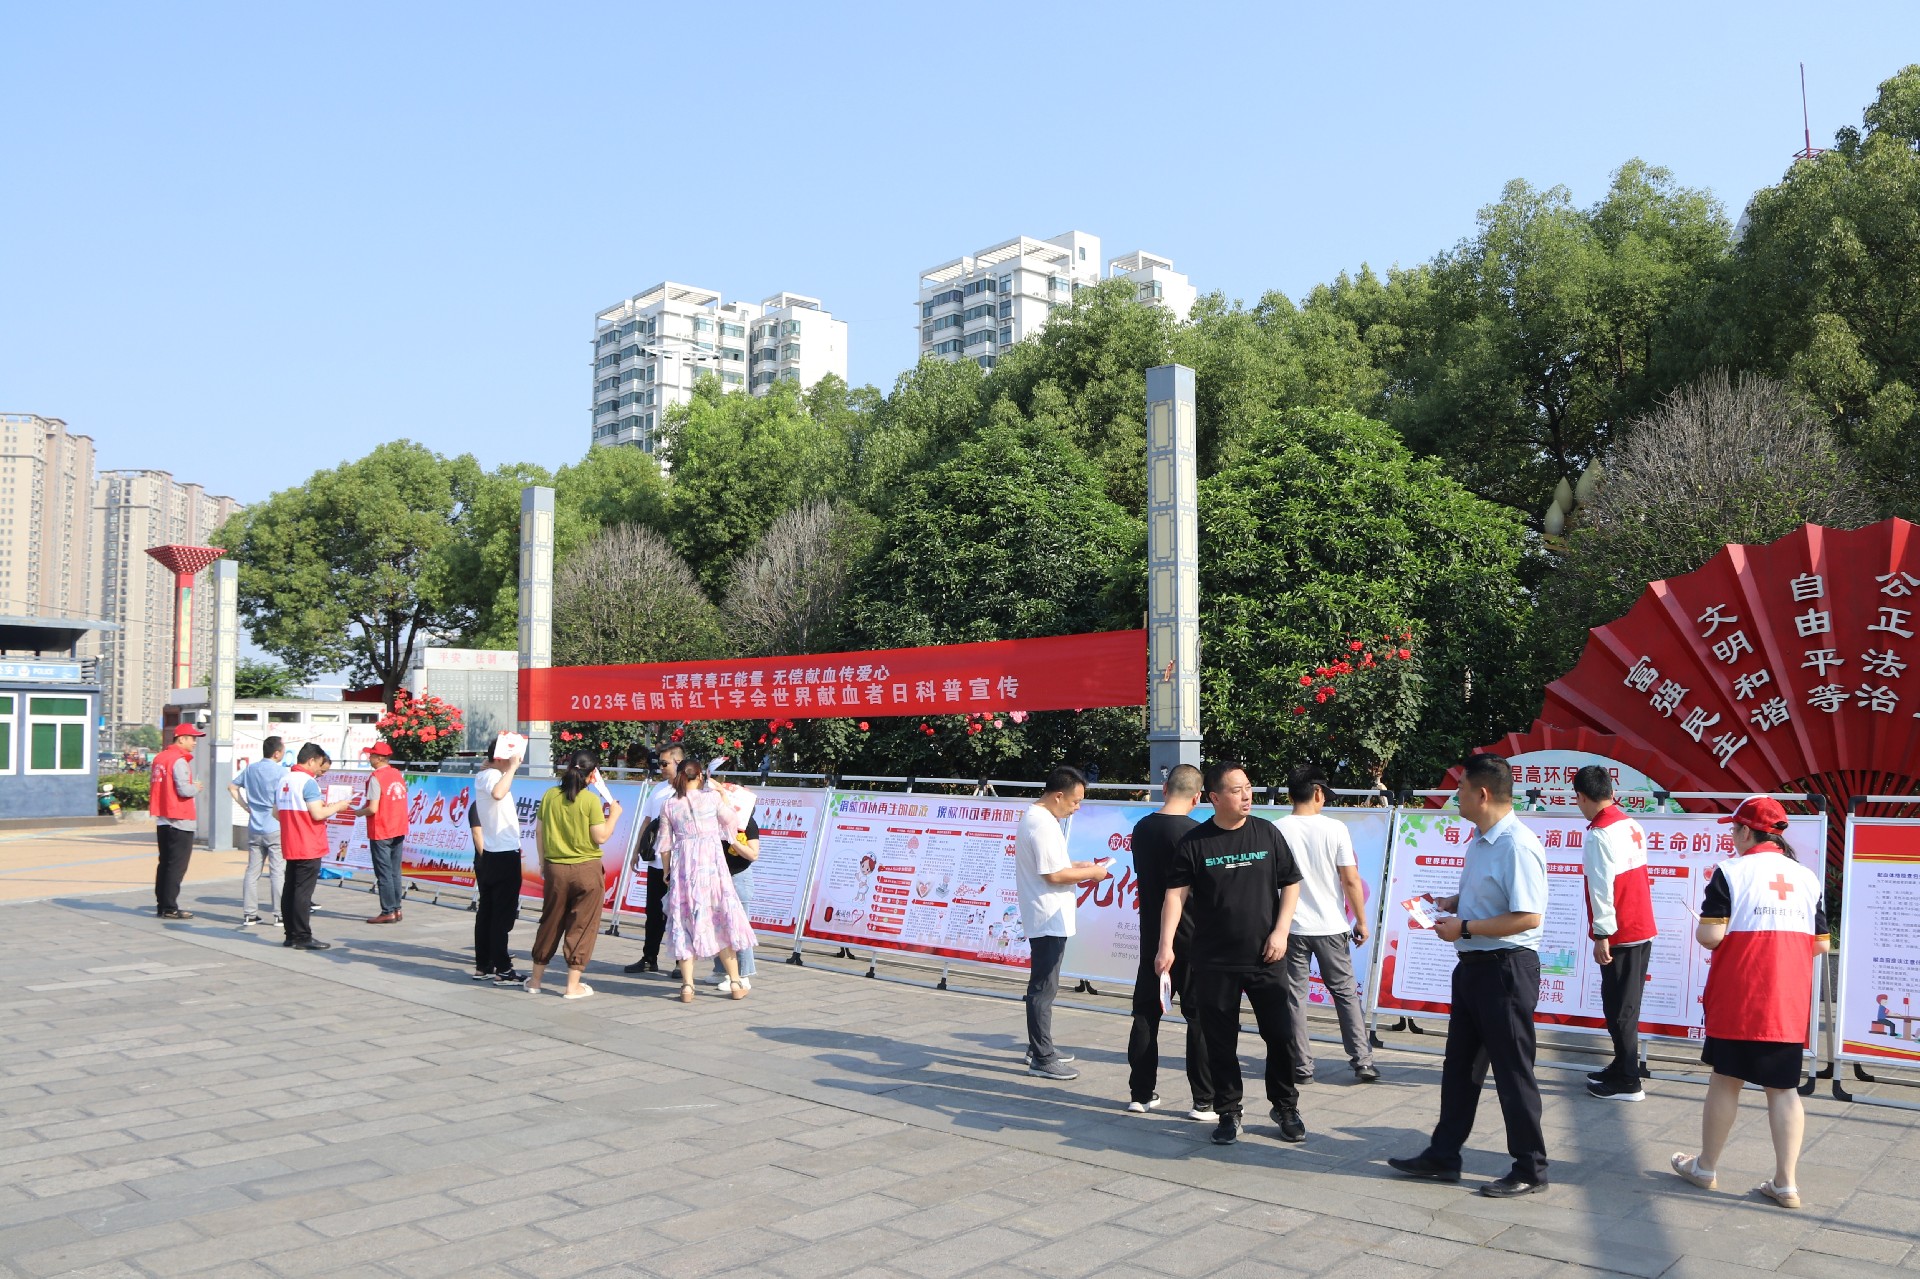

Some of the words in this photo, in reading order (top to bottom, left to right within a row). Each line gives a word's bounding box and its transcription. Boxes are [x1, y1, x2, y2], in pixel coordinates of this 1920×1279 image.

[571, 675, 1019, 711] 2023年信阳市红十字会世界献血者日科普宣传
[661, 671, 764, 690] 汇聚青春正能量
[772, 664, 891, 685] 无偿献血传爱心
[1697, 603, 1790, 732] 文明和谐
[1789, 572, 1851, 713] 自由平等
[1854, 571, 1920, 714] 公正法治
[1623, 655, 1748, 769] 富强民主
